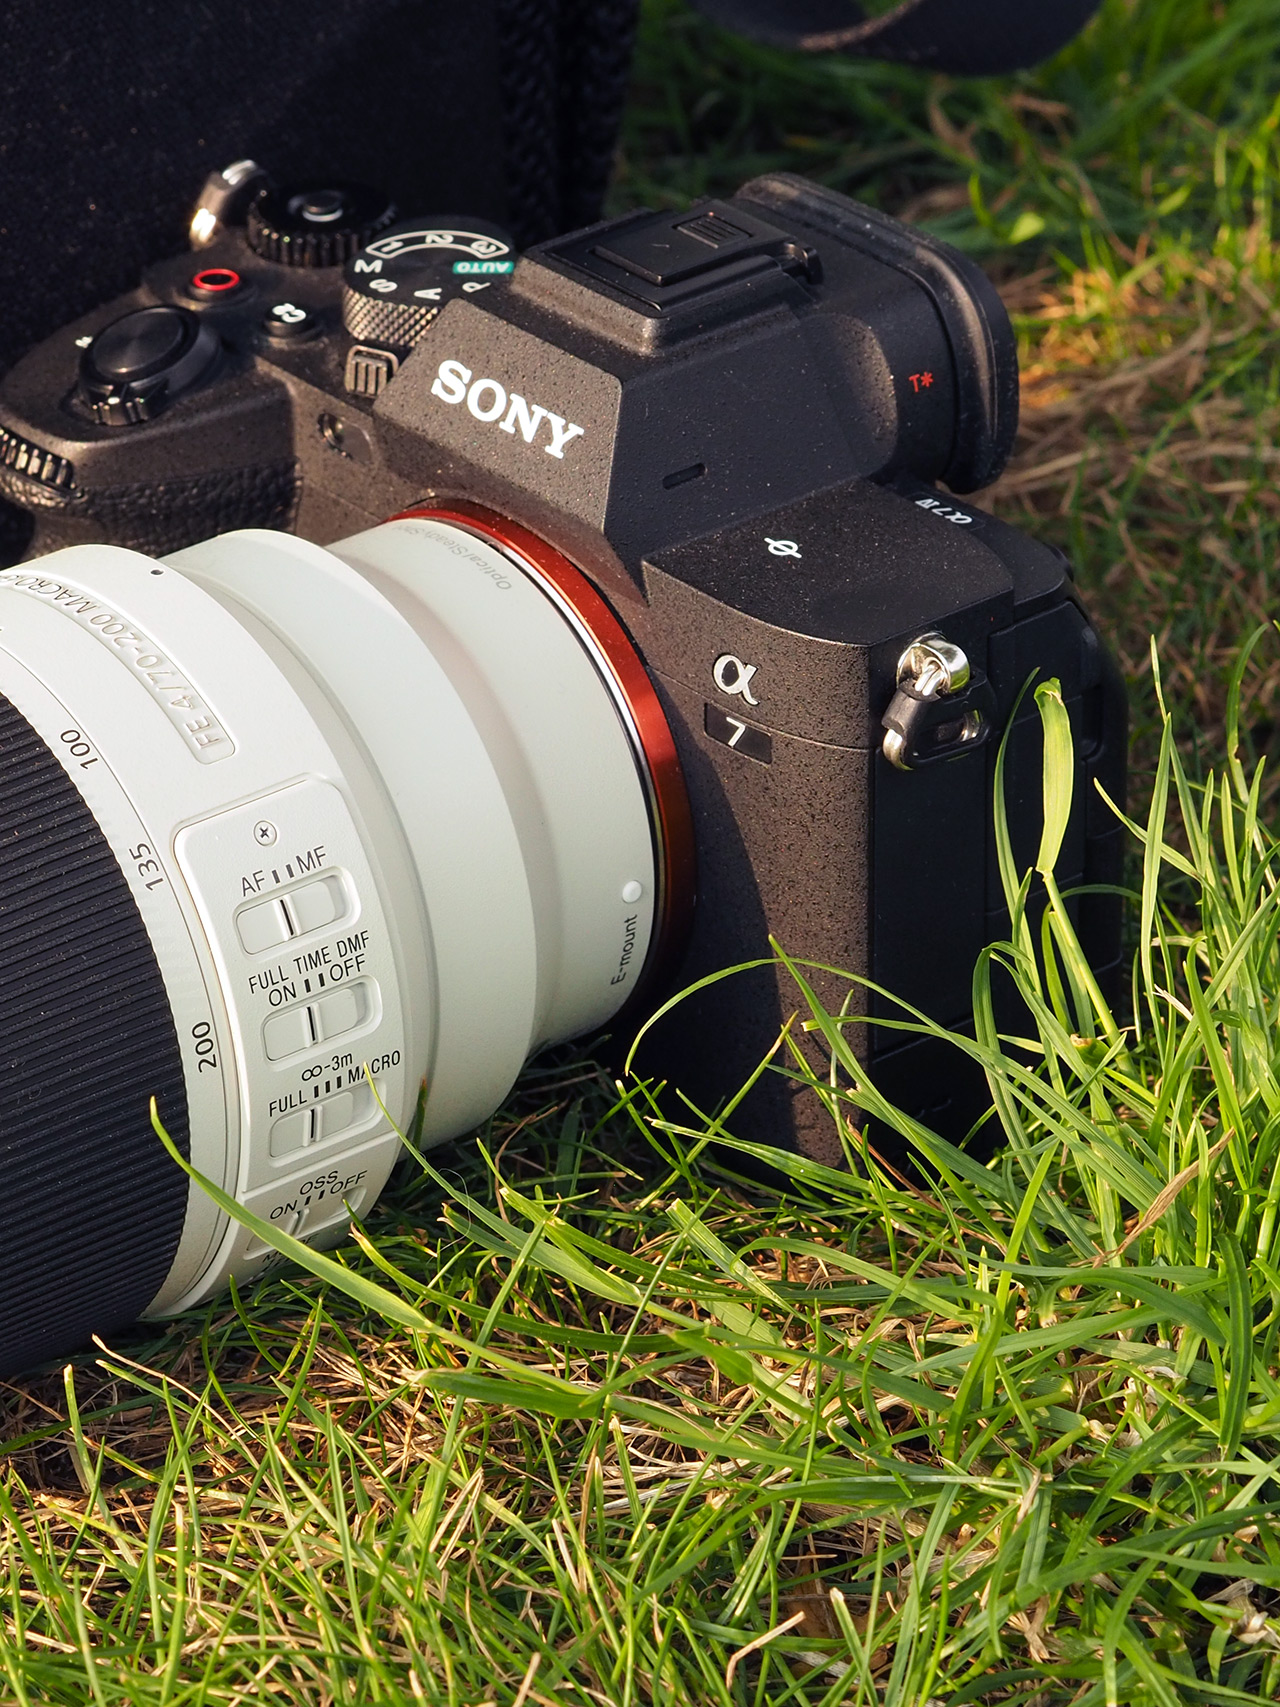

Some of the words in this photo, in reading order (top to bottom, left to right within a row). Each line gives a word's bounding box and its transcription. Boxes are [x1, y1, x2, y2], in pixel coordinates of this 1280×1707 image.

[354, 259, 383, 273] M
[456, 261, 510, 273] AUTO
[369, 278, 398, 293] S
[413, 287, 443, 300] A
[462, 281, 491, 293] P
[430, 359, 584, 460] SONY
[14, 577, 97, 614] MACRO
[60, 729, 99, 770] 100
[184, 714, 220, 750] FE
[725, 716, 746, 748] 7
[129, 842, 164, 891] 135
[240, 869, 266, 897] AF
[296, 845, 328, 874] MF
[248, 965, 290, 994] FULL
[292, 945, 332, 976] TIME
[336, 930, 371, 958] DMF
[610, 914, 638, 985] E-mount
[268, 982, 298, 1007] ON
[329, 953, 367, 983] OFF
[191, 1021, 218, 1073] 200
[269, 1090, 308, 1117] FULL
[269, 1199, 298, 1220] ON
[330, 1169, 368, 1195] OFF
[299, 1170, 339, 1195] OSS
